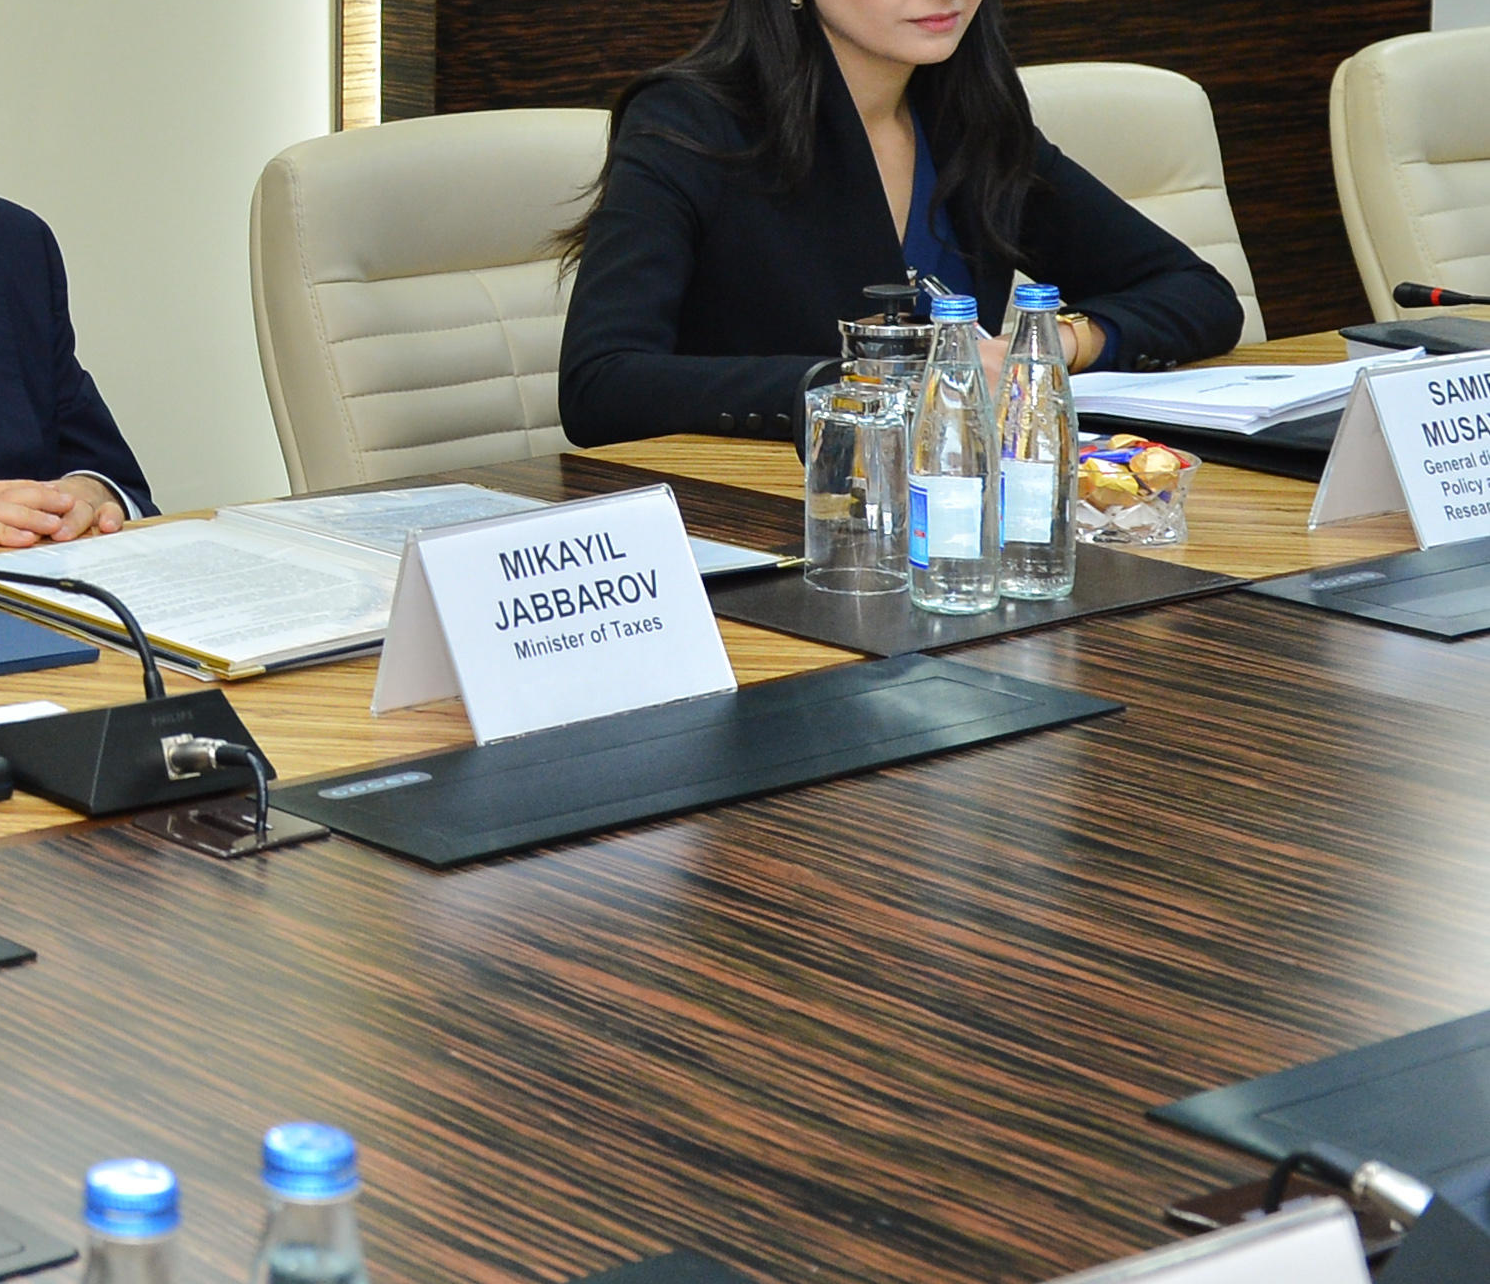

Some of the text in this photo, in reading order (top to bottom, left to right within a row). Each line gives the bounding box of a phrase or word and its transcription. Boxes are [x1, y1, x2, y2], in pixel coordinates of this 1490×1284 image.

[1422, 412, 1490, 447] MUSA
[1424, 452, 1477, 475] General
[1441, 478, 1483, 497] Policy
[499, 532, 627, 582] MIKAYIL
[495, 569, 659, 631] JABBAROV
[514, 615, 663, 660] Minister of Taxes
